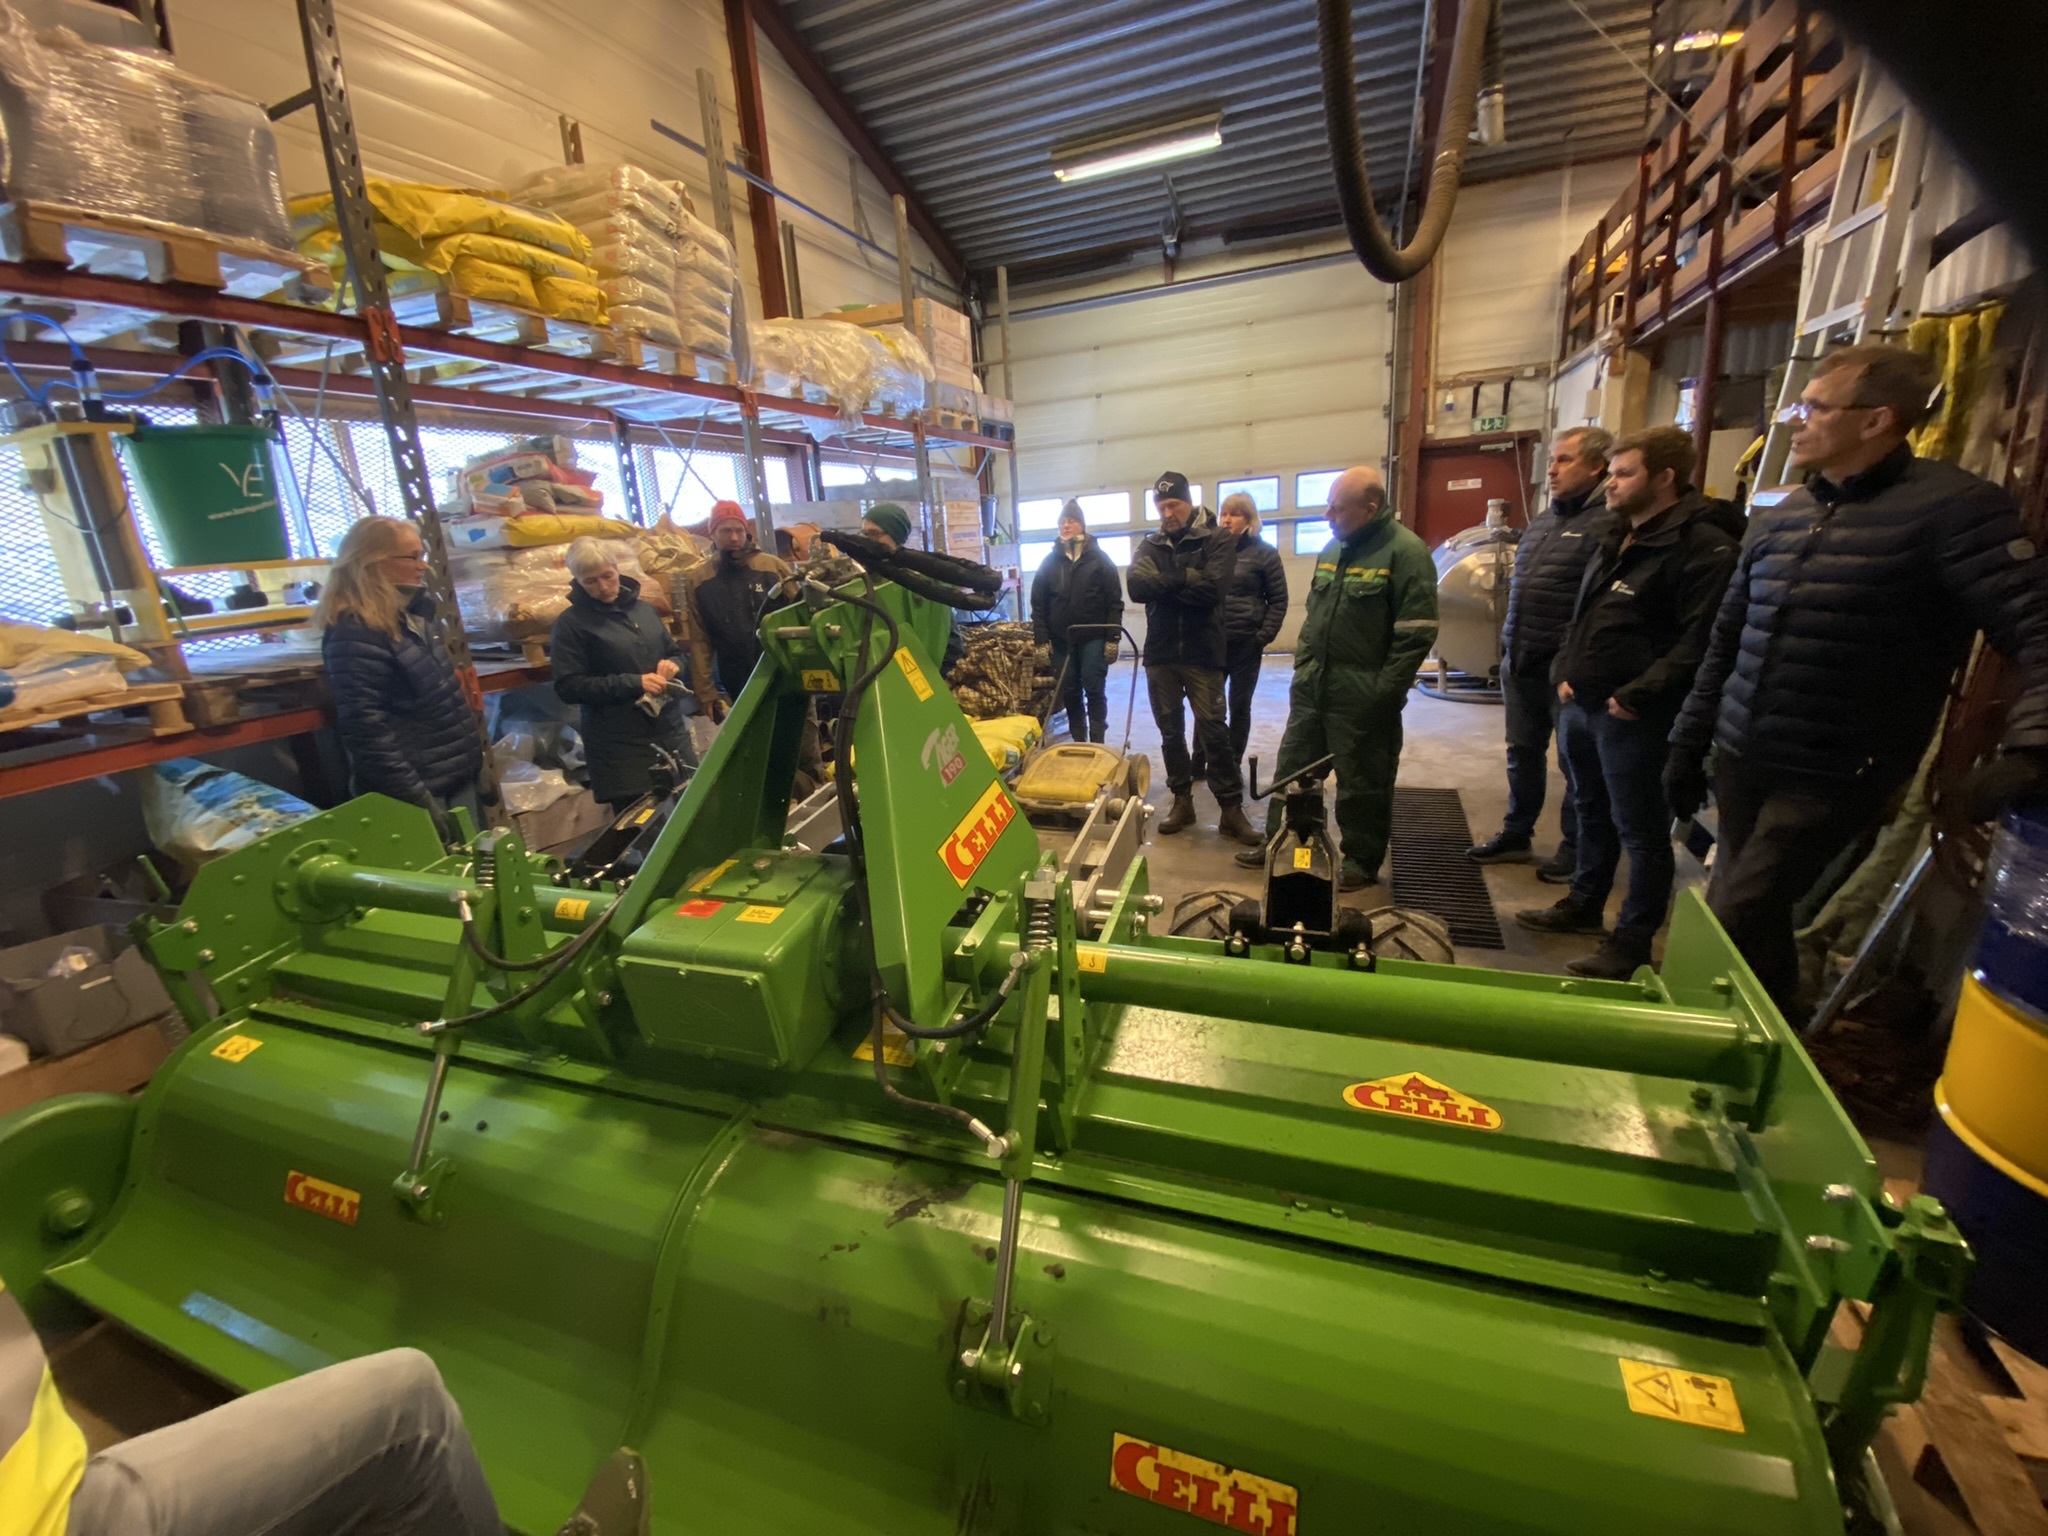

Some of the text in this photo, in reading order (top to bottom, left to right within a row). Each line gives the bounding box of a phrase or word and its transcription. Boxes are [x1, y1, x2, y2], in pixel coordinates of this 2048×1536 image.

[944, 756, 964, 780] 190
[945, 791, 1016, 880] CELLI
[1354, 1085, 1491, 1127] CELLI
[286, 1174, 359, 1226] CELLI
[1113, 1442, 1296, 1536] CELLI
